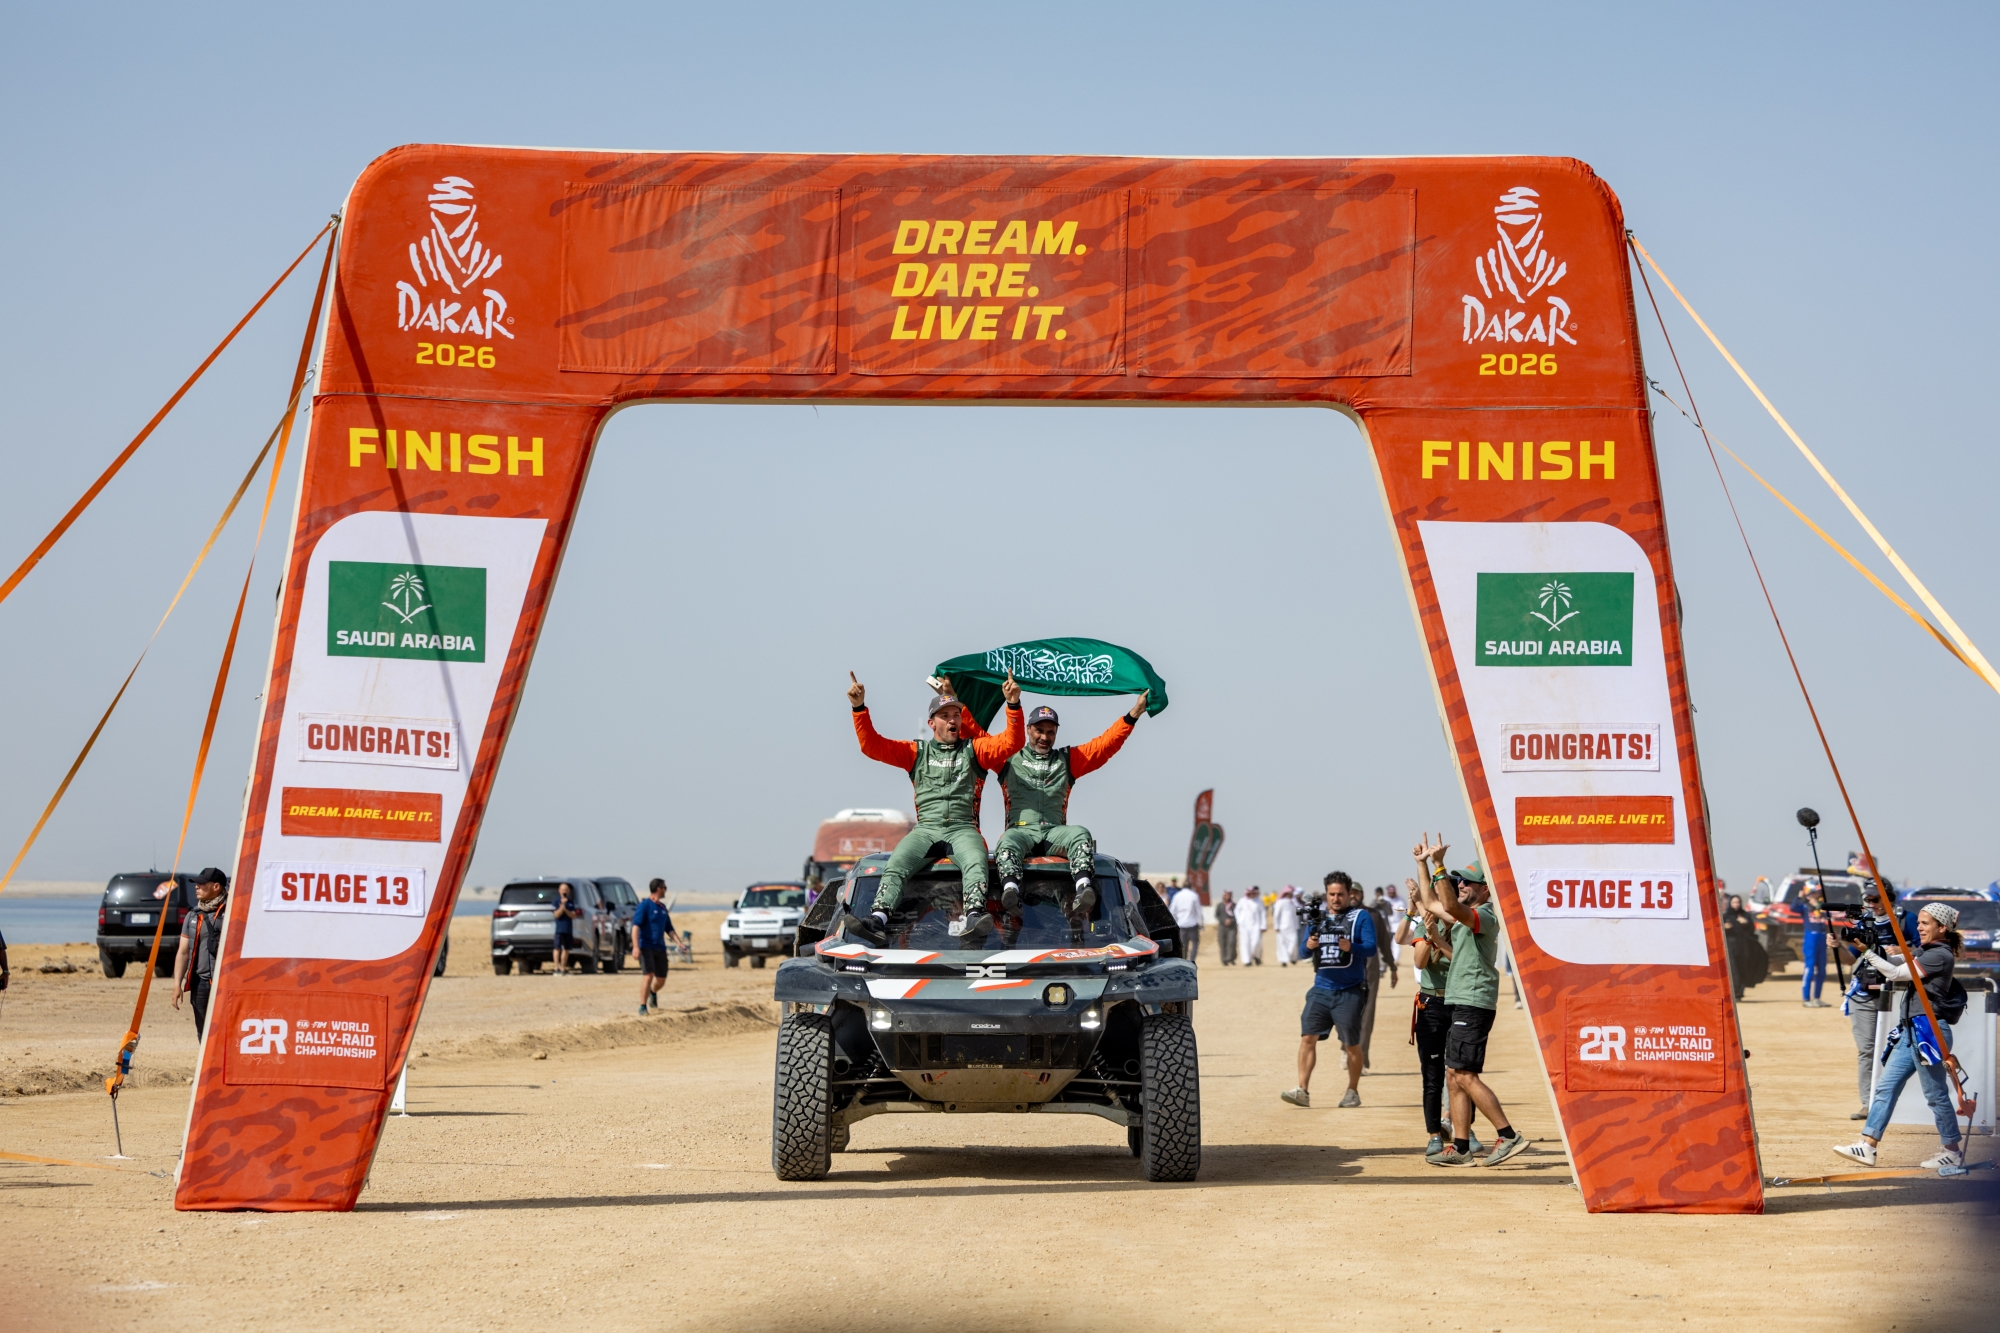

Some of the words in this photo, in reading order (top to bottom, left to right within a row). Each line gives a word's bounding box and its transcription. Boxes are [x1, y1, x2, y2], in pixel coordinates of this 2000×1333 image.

[892, 220, 1087, 256] DREAM.
[891, 262, 1040, 298] DARE.
[396, 279, 515, 340] DAKAR
[890, 305, 1004, 340] LIVE
[1011, 305, 1067, 341] IT.
[1462, 293, 1578, 347] DAKAR
[416, 342, 496, 369] 2026
[1479, 353, 1558, 376] 2026
[348, 427, 544, 477] FINISH
[1421, 440, 1615, 480] FINISH
[336, 629, 395, 647] SAUDI
[400, 632, 476, 651] ARABIA
[1484, 640, 1543, 656] SAUDI
[1548, 640, 1623, 655] ARABIA
[307, 723, 450, 759] CONGRATS!
[1510, 733, 1651, 761] CONGRATS!
[289, 805, 342, 818] DREAM.
[344, 807, 384, 820] DARE.
[386, 810, 416, 822] LIVE
[418, 811, 434, 823] IT.
[1523, 814, 1575, 826] DREAM.
[1577, 814, 1617, 825] DARE.
[1619, 814, 1649, 825] LIVE
[1650, 814, 1666, 826] IT.
[281, 872, 368, 904] STAGE
[375, 875, 409, 906] 13
[1546, 879, 1632, 909] STAGE
[1640, 880, 1673, 909] 13
[239, 1018, 289, 1055] 2R
[295, 1031, 375, 1048] RALLY-RAID
[296, 1020, 309, 1029] FIA
[311, 1021, 327, 1029] FIM
[331, 1020, 370, 1033] WORLD
[1634, 1026, 1647, 1035] FIA
[1668, 1025, 1707, 1036] WORLD
[295, 1044, 377, 1059] CHAMPIONSHIP
[1579, 1025, 1627, 1061] 2R
[1633, 1037, 1712, 1051] RALLY-RAID
[1634, 1050, 1715, 1062] CHAMPIONSHIP
